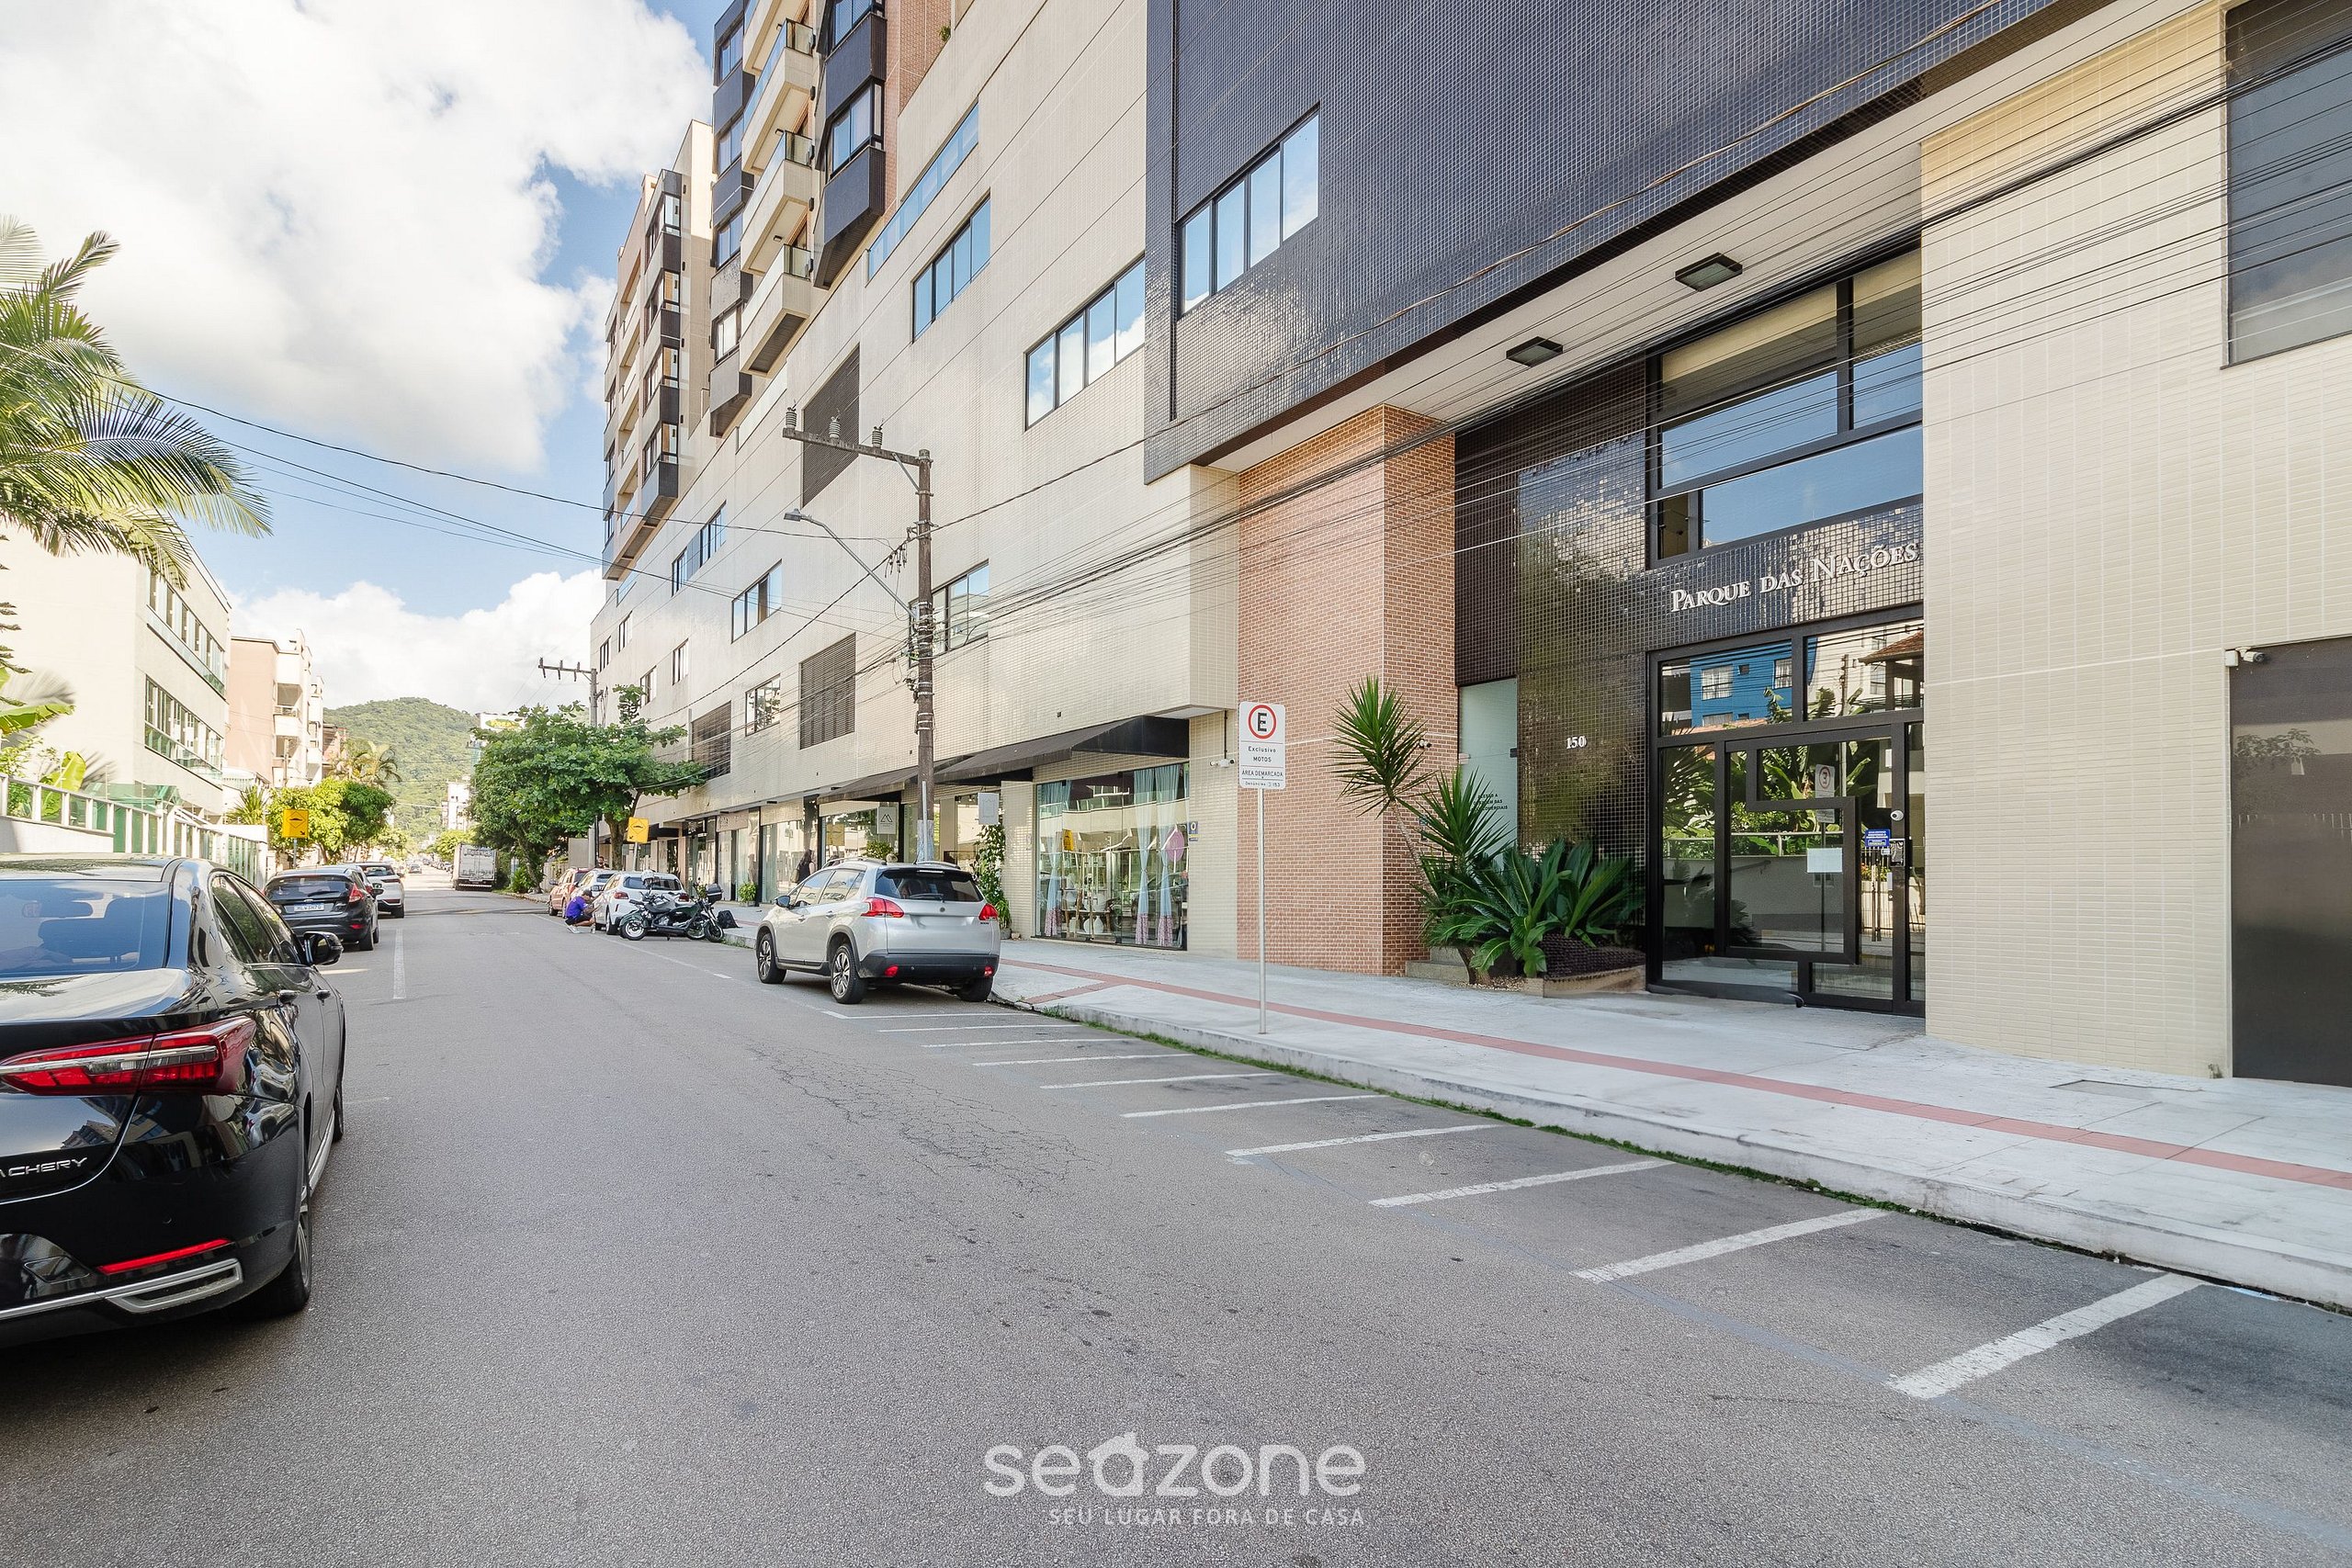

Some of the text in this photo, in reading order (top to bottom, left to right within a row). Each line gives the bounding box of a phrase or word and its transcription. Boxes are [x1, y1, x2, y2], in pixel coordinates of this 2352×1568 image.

[1670, 543, 1920, 613] PARQUE DAS NAÇÕES
[1257, 712, 1268, 732] E
[1248, 745, 1277, 753] Exclusivo
[1566, 735, 1587, 750] 150
